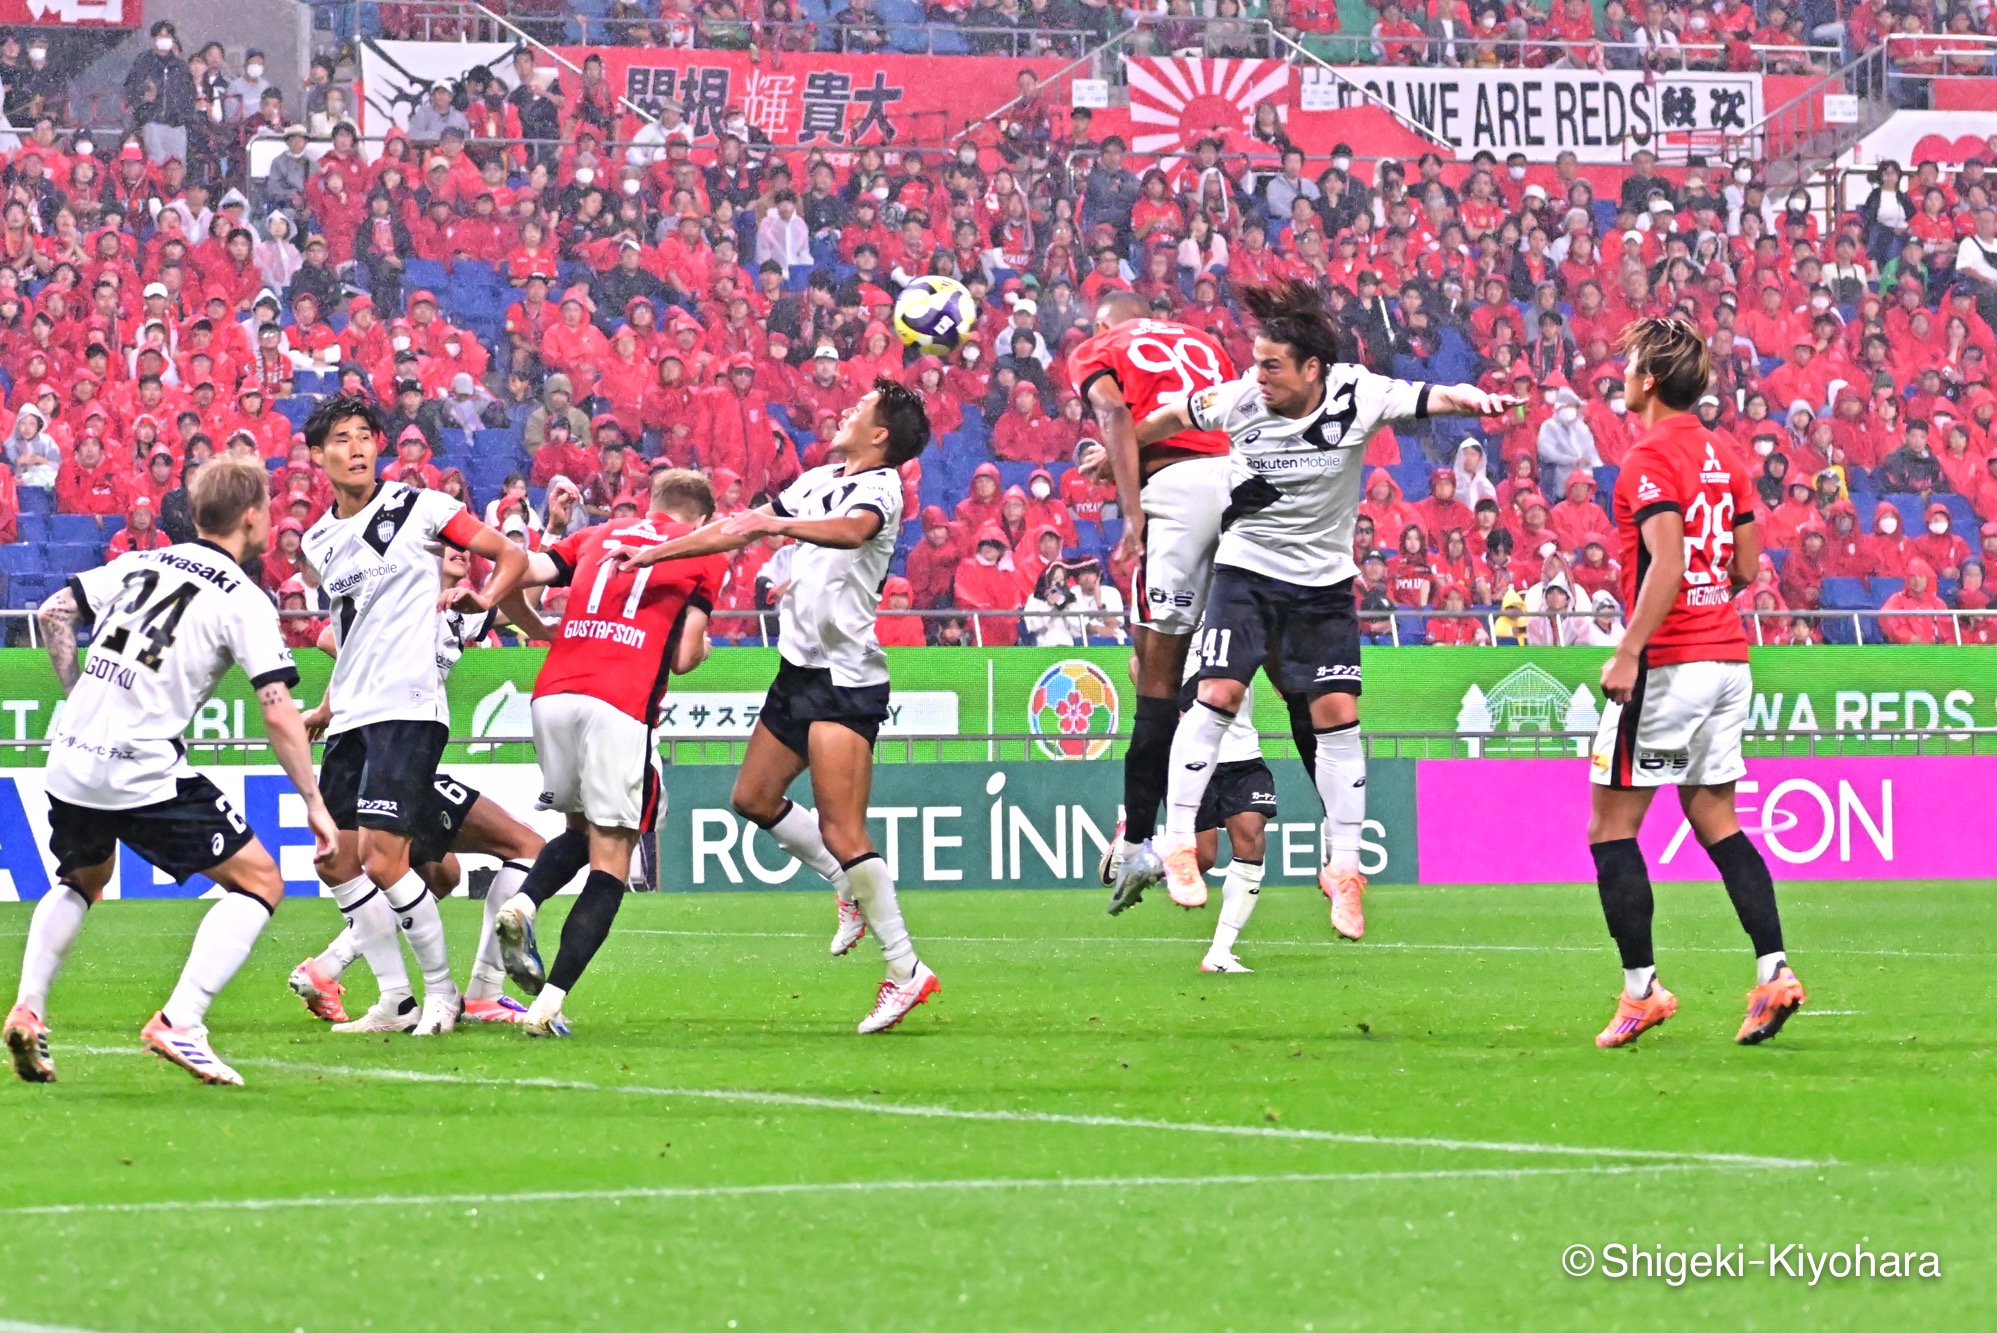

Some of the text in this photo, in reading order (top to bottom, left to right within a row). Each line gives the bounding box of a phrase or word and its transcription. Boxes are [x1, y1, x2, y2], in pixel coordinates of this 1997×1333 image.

[1473, 82, 1545, 147] ARE
[1557, 80, 1653, 147] REDS
[1246, 455, 1341, 473] Rakuten Mobile
[139, 552, 241, 594] wasaki
[330, 563, 398, 594] Rakuten Mobile
[93, 568, 202, 673] 24
[564, 619, 647, 650] GUSTAFSON
[1202, 627, 1232, 668] 41
[1835, 689, 1975, 741] REDS
[433, 779, 468, 805] 6
